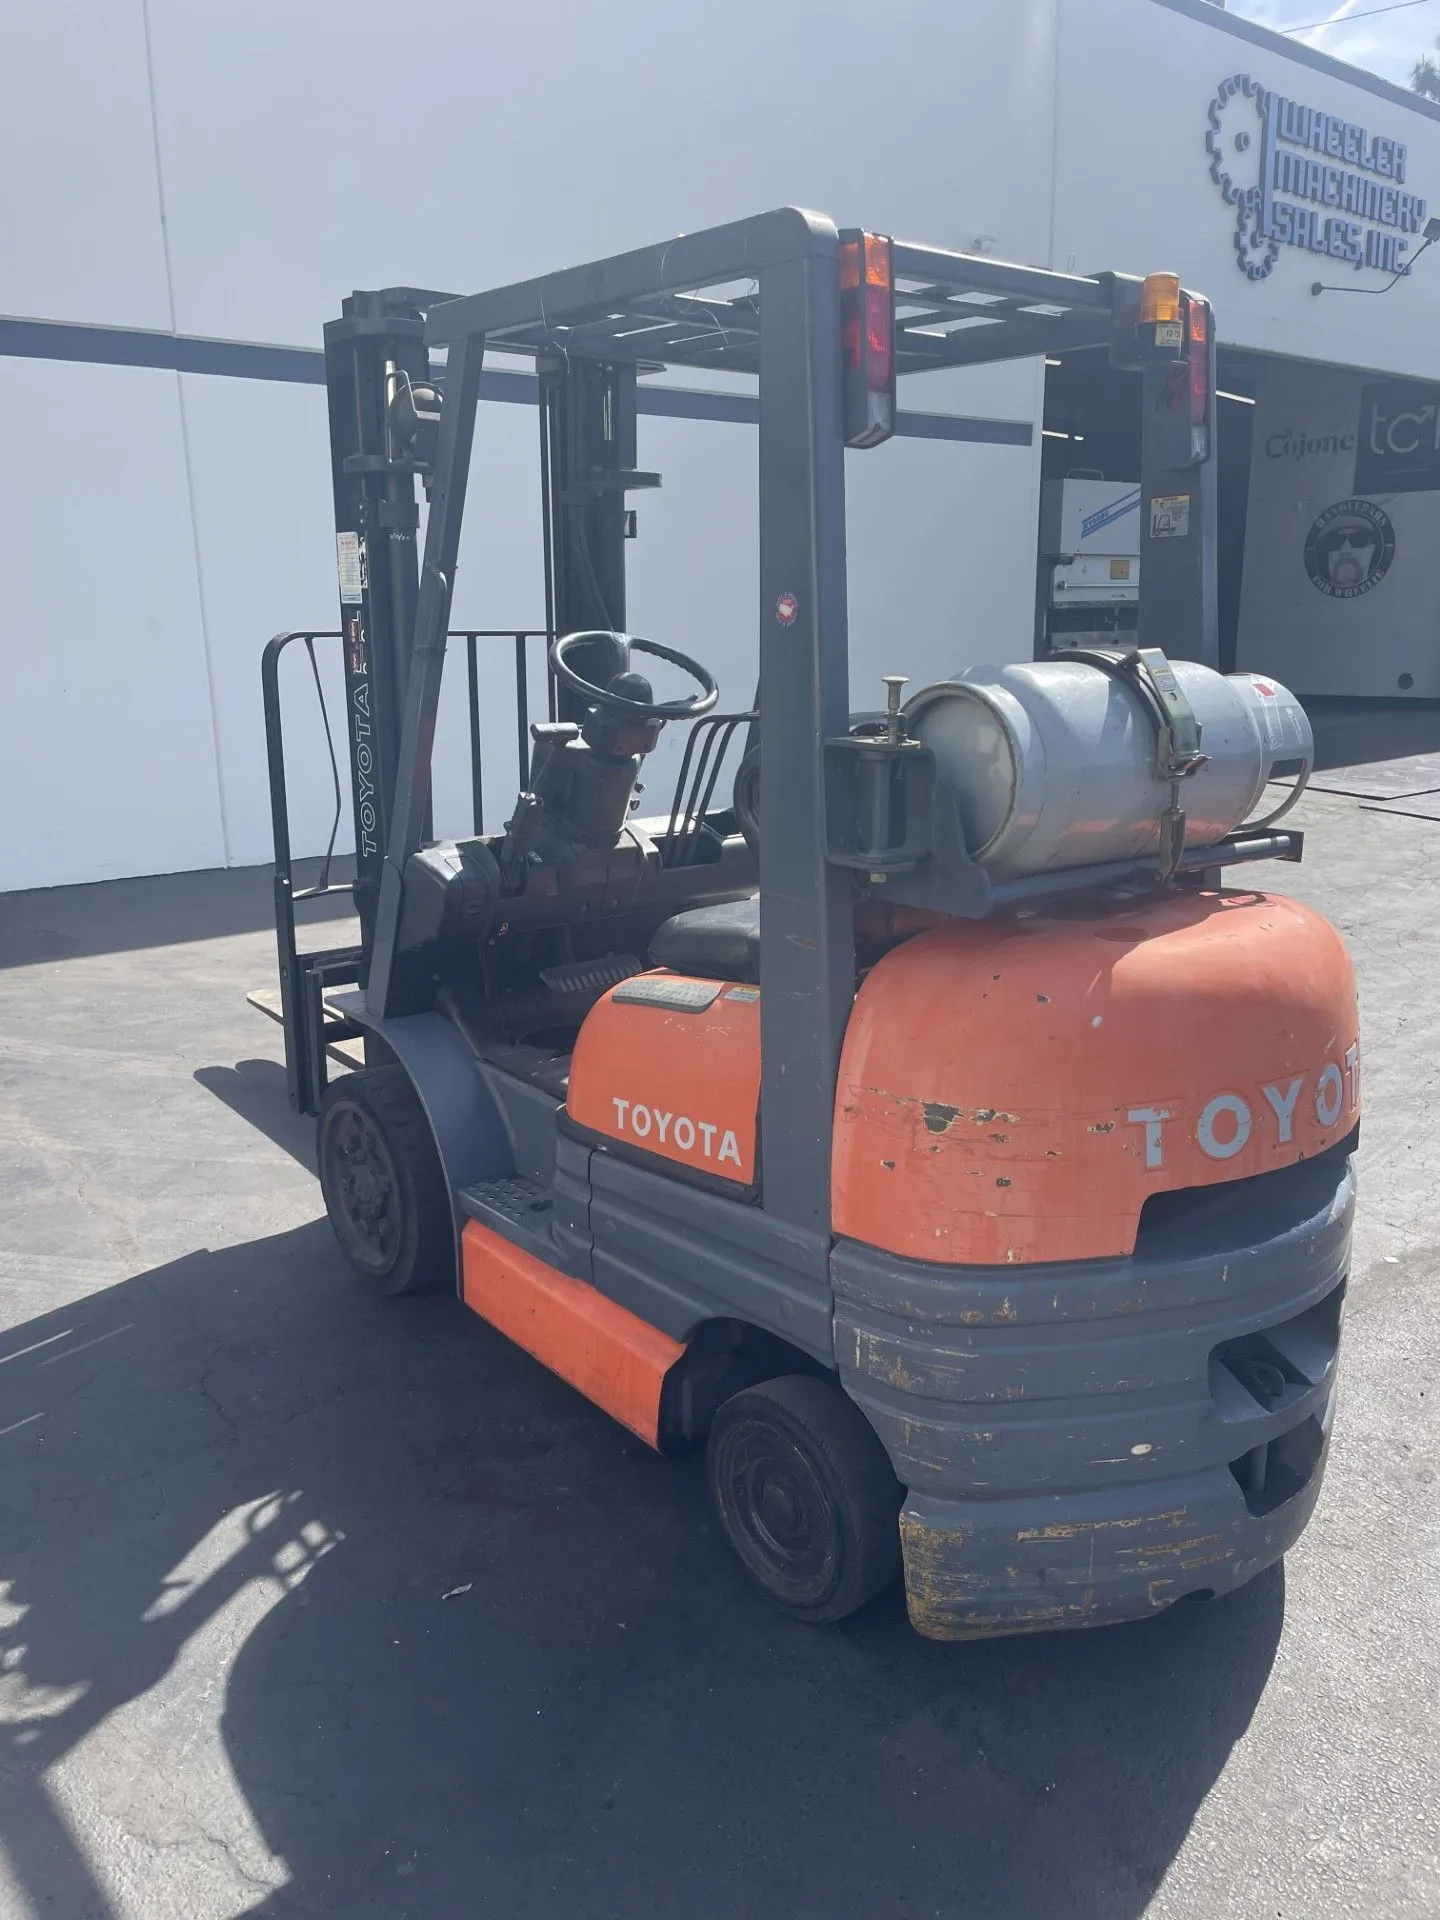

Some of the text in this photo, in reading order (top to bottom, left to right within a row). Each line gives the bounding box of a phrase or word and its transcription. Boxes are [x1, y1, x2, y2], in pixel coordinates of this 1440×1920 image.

[1277, 96, 1408, 184] WHEELER
[1273, 150, 1427, 233] MACHINERY
[353, 683, 377, 857] TOYOTA
[613, 1097, 742, 1167] TOYOTA
